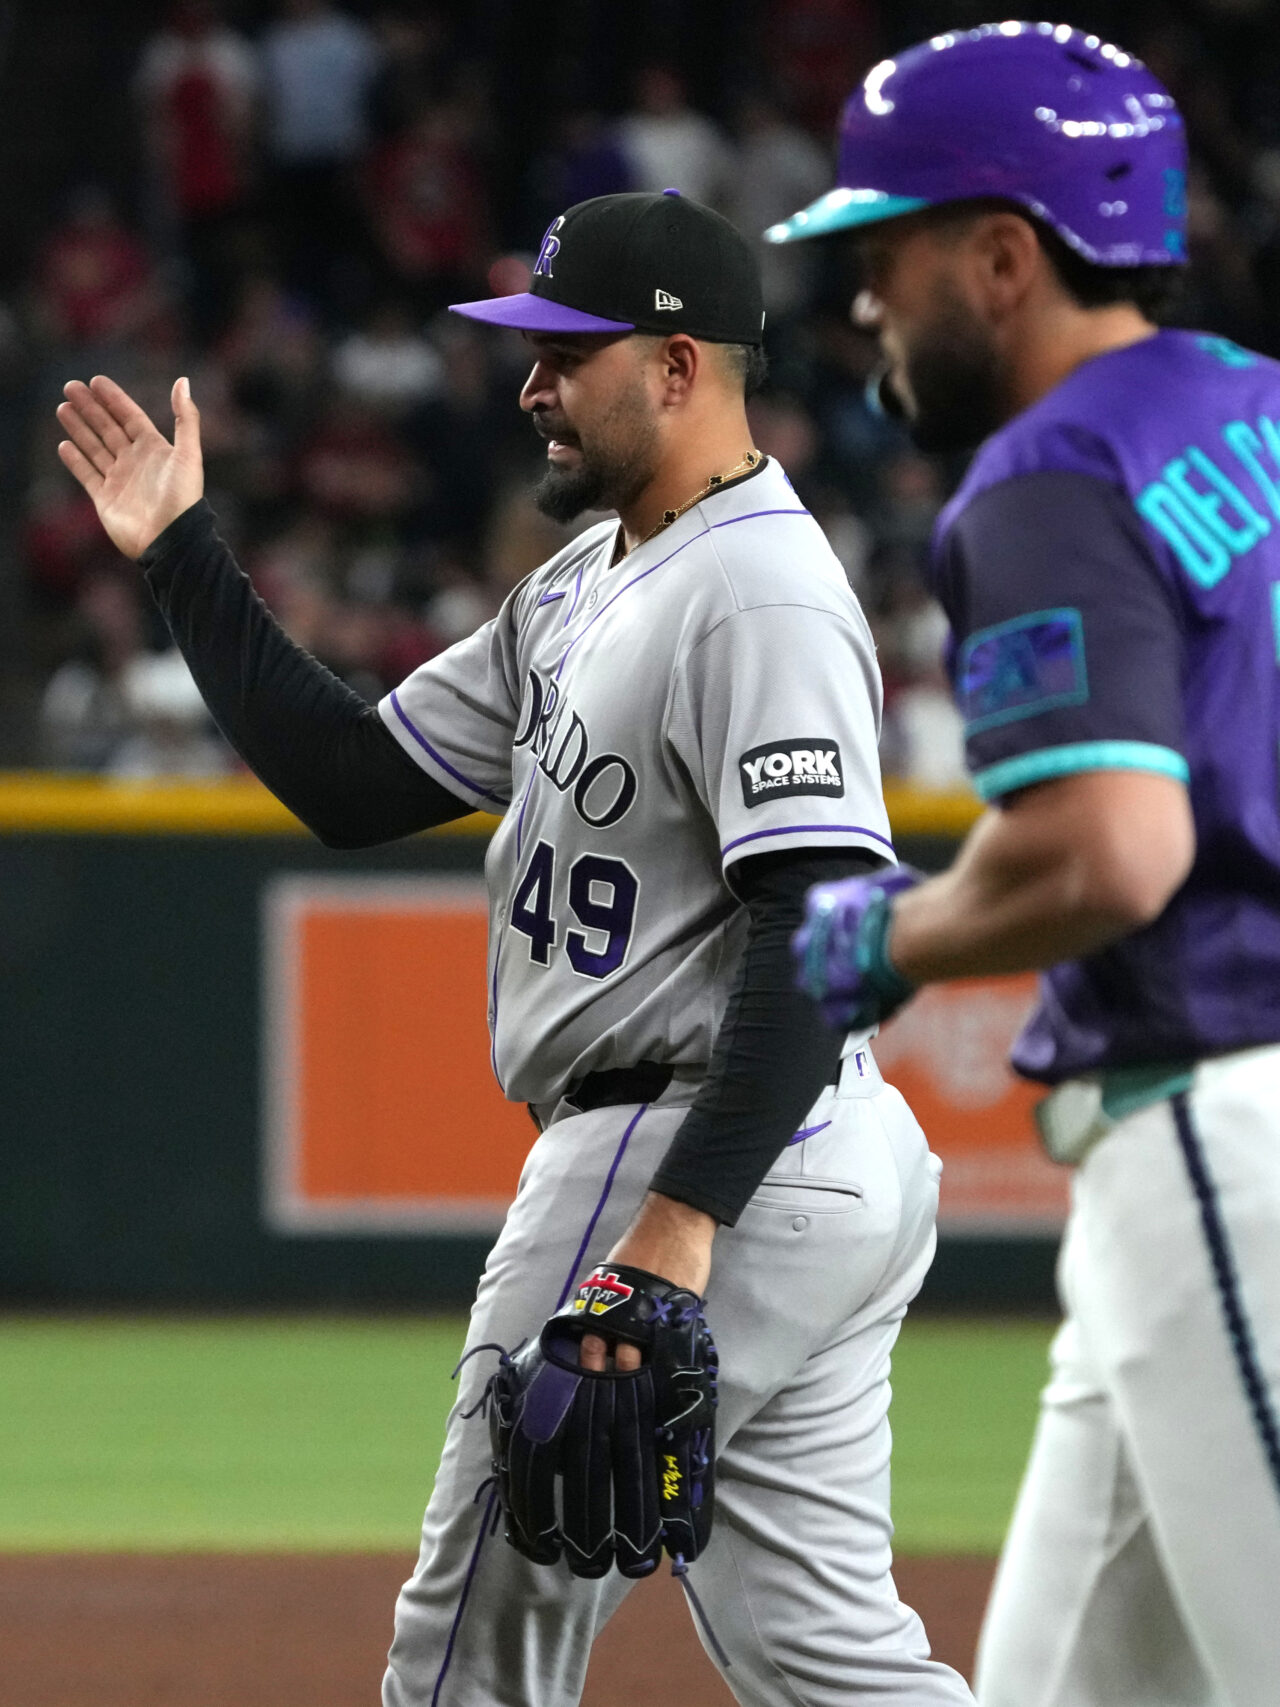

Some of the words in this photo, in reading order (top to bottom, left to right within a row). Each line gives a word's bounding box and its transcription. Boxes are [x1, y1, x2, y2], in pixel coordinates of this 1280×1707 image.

[1135, 446, 1271, 588] DEL
[742, 749, 840, 785] YORK
[751, 776, 790, 794] SPACE
[792, 774, 842, 787] SYSTEMS
[509, 838, 641, 982] 49
